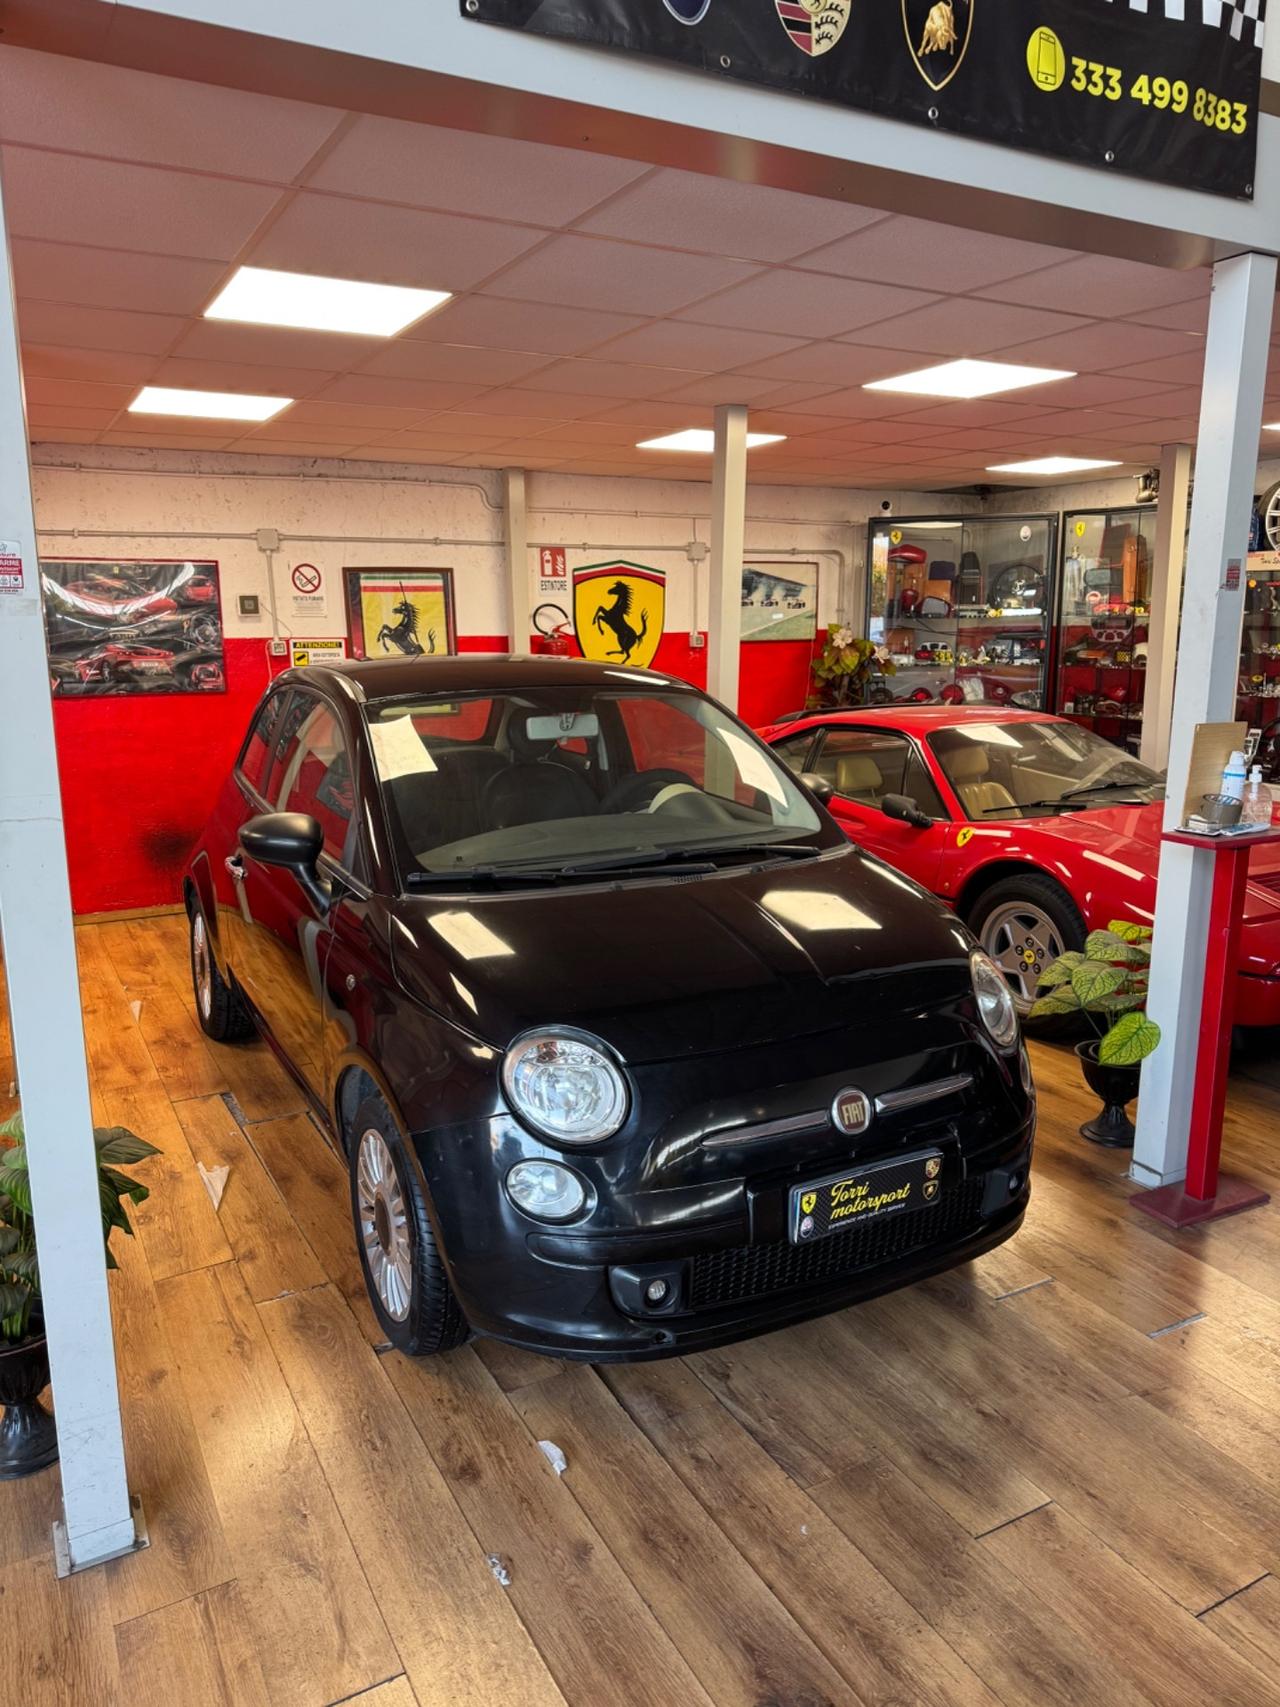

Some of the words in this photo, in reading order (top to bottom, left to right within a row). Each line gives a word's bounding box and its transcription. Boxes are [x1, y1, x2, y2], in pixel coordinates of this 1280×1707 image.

[1071, 56, 1122, 100] 333
[1130, 74, 1188, 113] 499
[1193, 88, 1248, 134] 8383
[841, 1101, 865, 1125] FIAT
[830, 1183, 911, 1220] motorsport
[831, 1180, 870, 1206] Torri
